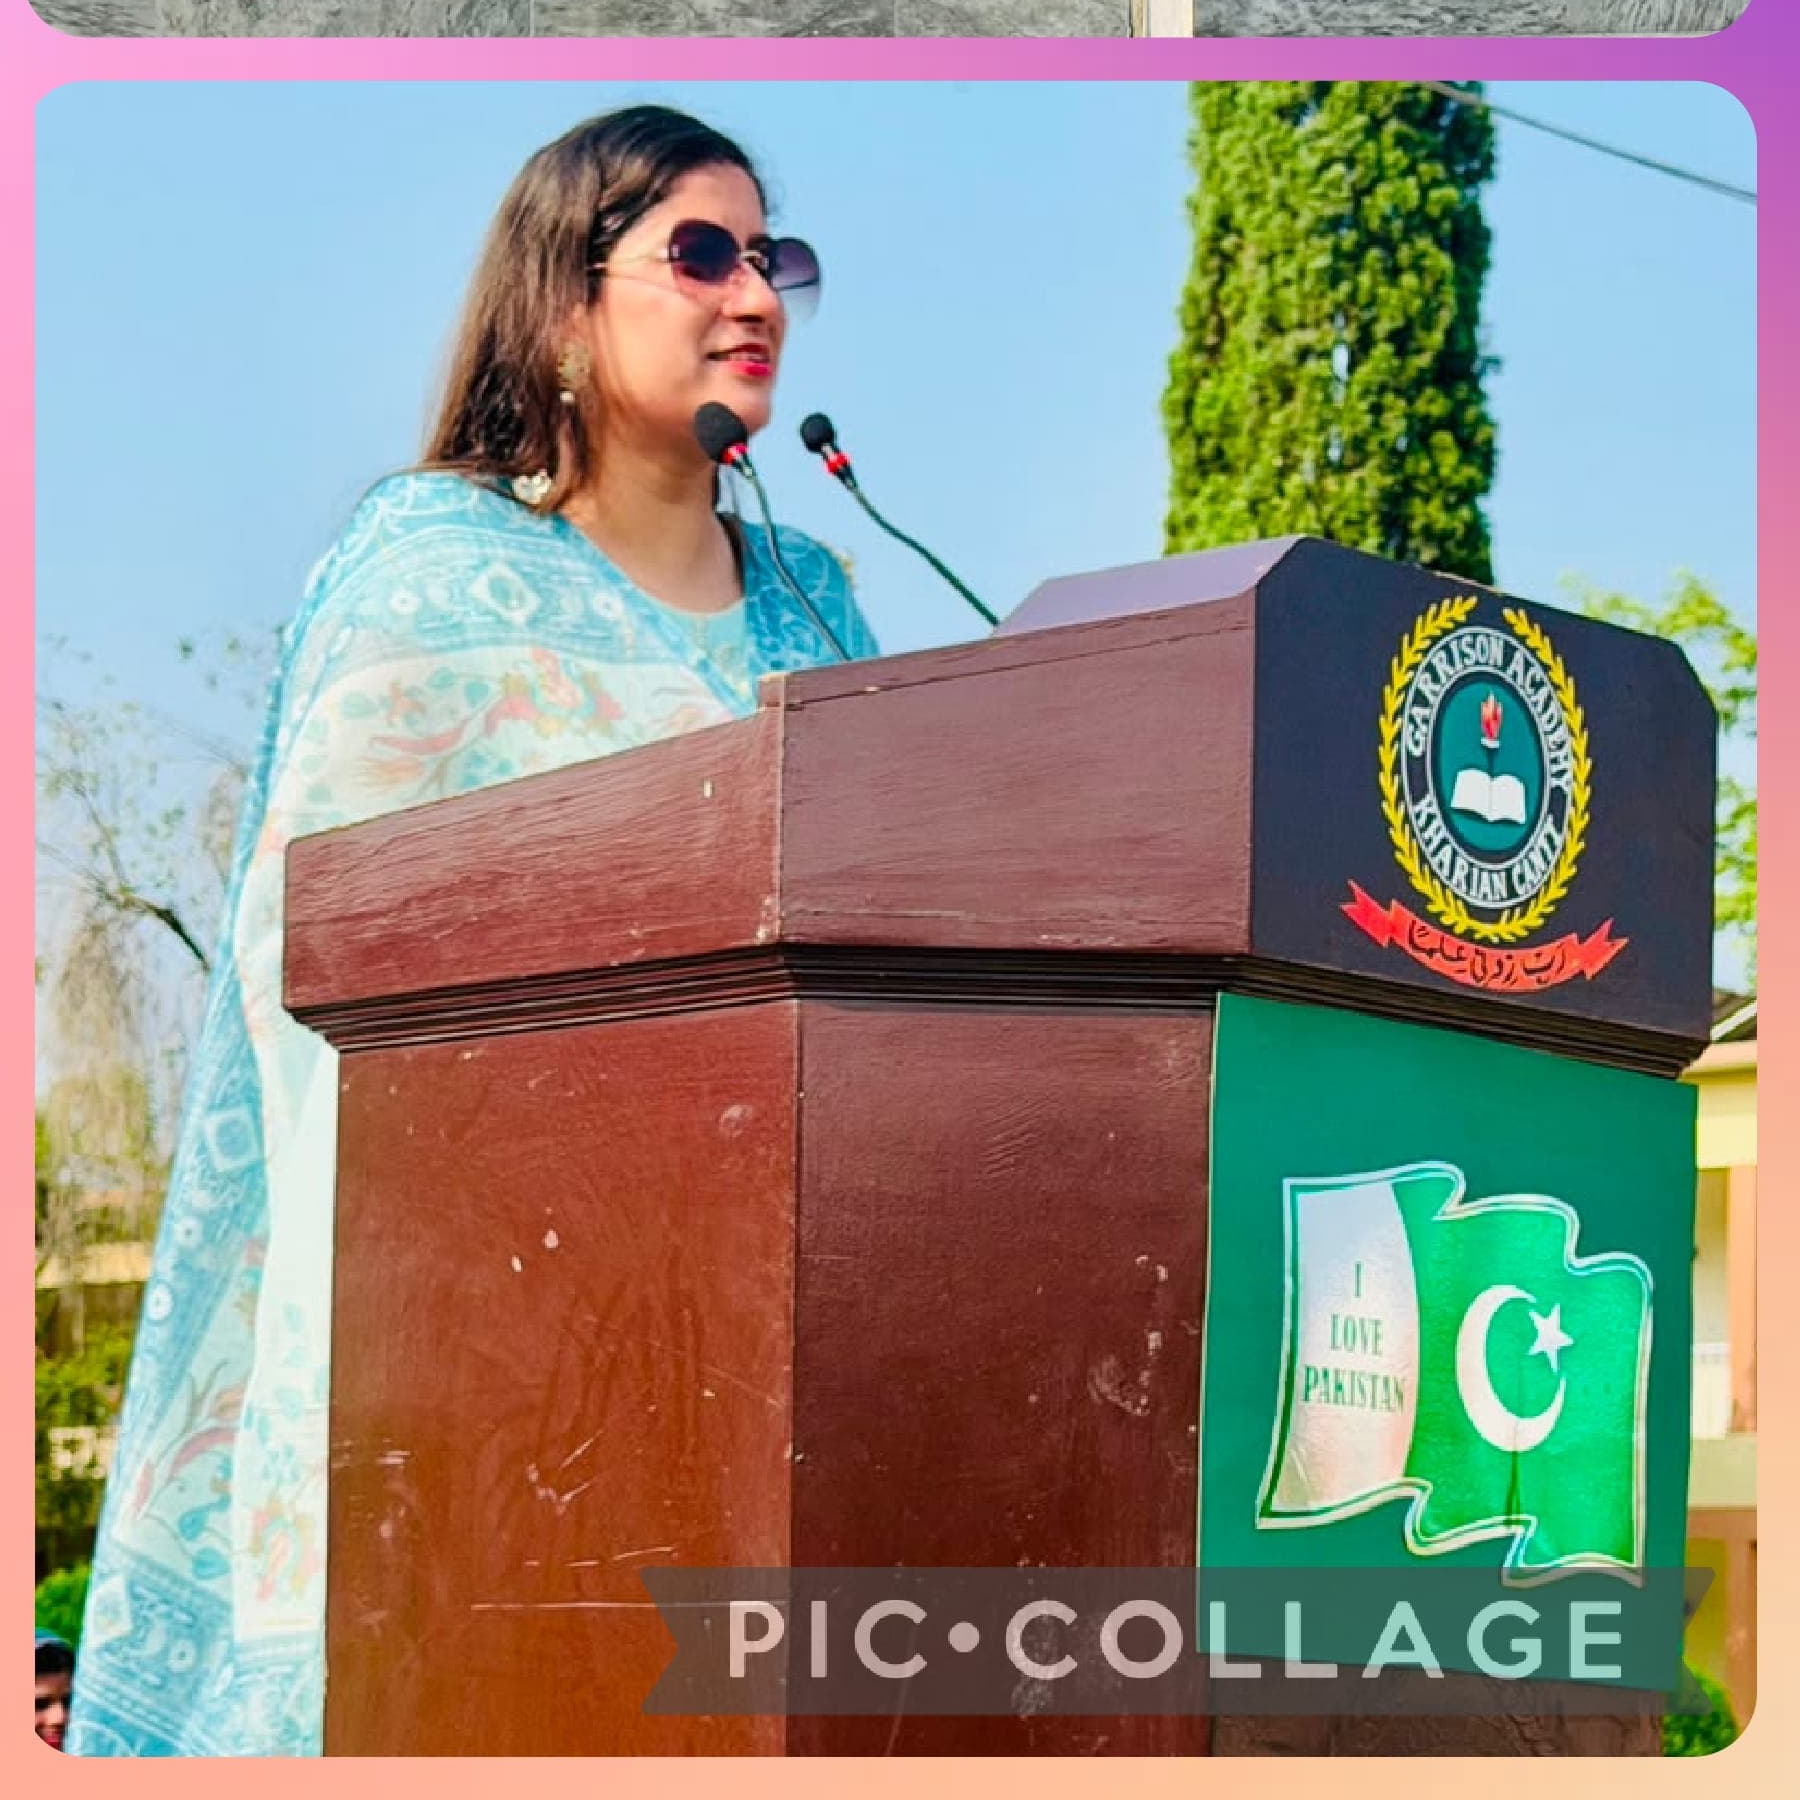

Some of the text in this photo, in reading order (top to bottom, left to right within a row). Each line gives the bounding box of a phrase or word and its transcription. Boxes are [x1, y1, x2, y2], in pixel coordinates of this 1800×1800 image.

[1406, 633, 1573, 792] GARRISON ACADEMY
[1412, 793, 1508, 899] KHARIAN
[1354, 1261, 1362, 1298] I
[1330, 1313, 1383, 1356] LOVE
[1303, 1364, 1405, 1414] PAKISTAN
